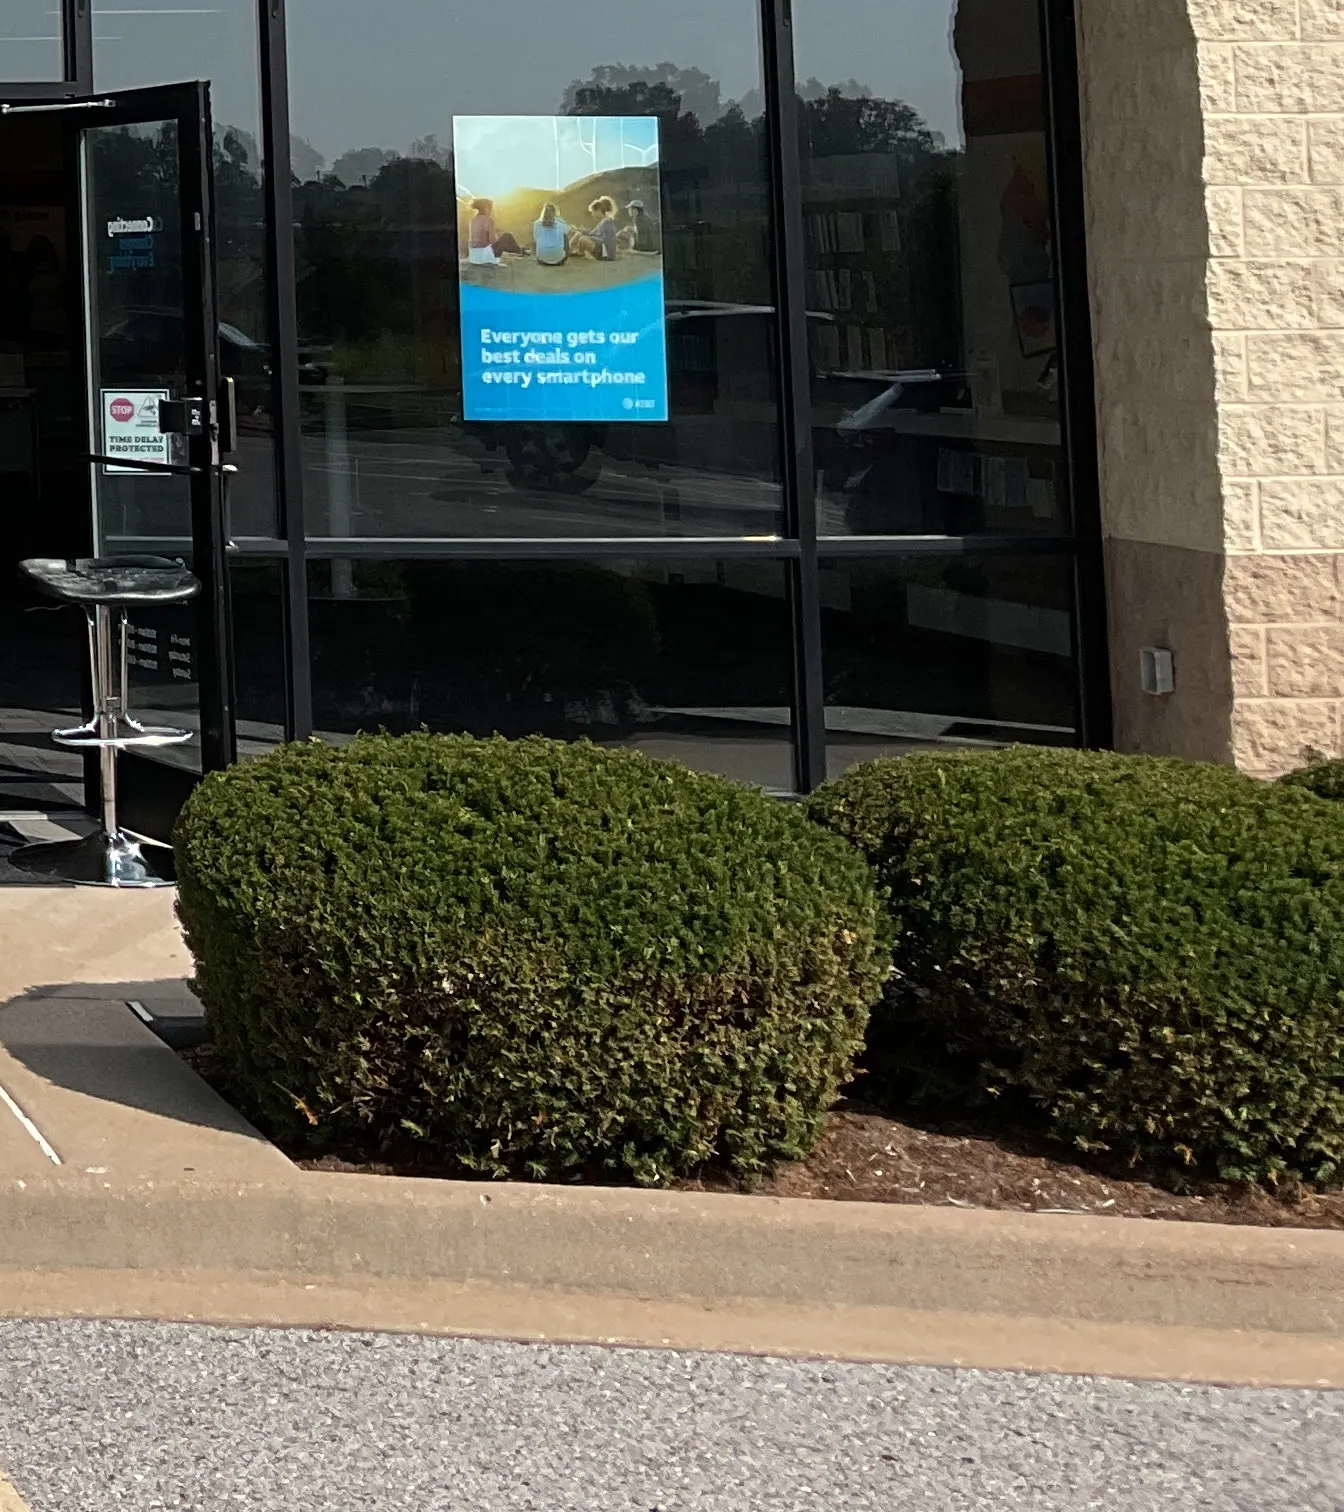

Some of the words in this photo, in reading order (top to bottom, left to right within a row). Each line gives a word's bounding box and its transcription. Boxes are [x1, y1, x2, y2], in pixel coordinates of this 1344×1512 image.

[480, 329, 562, 348] Everyone
[567, 330, 605, 348] gets
[609, 330, 639, 345] our
[481, 348, 520, 364] best
[524, 348, 570, 365] deals
[574, 352, 596, 365] on
[481, 371, 532, 389] every
[537, 369, 645, 388] smartphone
[111, 405, 133, 415] STOP
[109, 436, 132, 444] TIME
[135, 436, 164, 444] DELAY
[109, 445, 164, 453] PROTECTED
